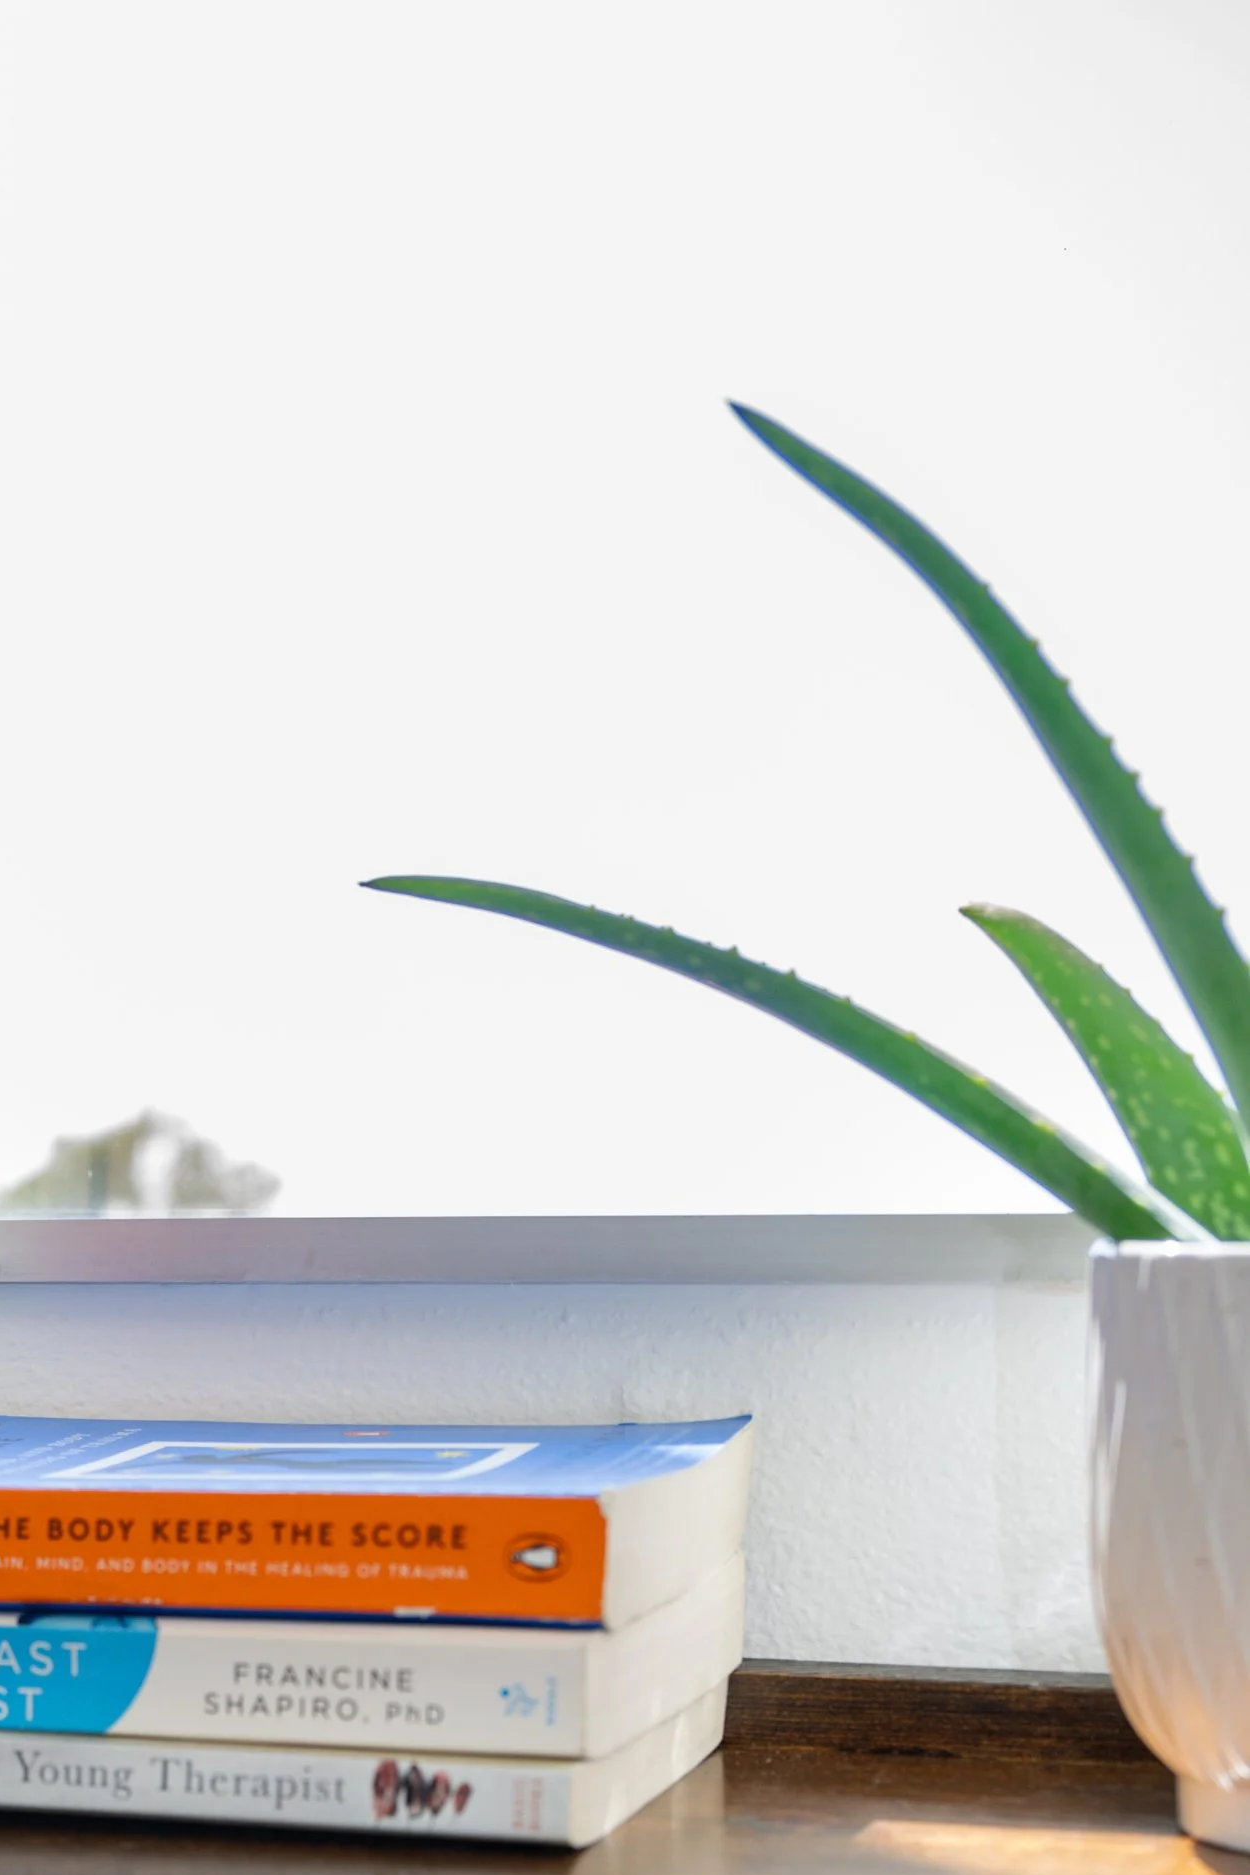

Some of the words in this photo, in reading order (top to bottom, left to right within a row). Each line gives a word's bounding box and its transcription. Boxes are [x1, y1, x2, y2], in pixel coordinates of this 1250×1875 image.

[47, 1517, 135, 1542] BODY
[152, 1519, 253, 1545] KEEPS
[271, 1520, 335, 1547] THE
[351, 1522, 469, 1549] SCORE
[96, 1557, 135, 1573] AND
[142, 1558, 191, 1574] BODY
[197, 1559, 218, 1575] IN
[224, 1559, 258, 1576] THE
[265, 1560, 350, 1578] HEALING
[356, 1562, 382, 1579] OF
[388, 1563, 469, 1580] TRAUMA
[233, 1662, 415, 1692] FRANCINE
[203, 1692, 370, 1725] SHAPIRO,
[385, 1701, 445, 1726] PhD
[13, 1750, 134, 1800] Young
[151, 1755, 347, 1809] Therapist
